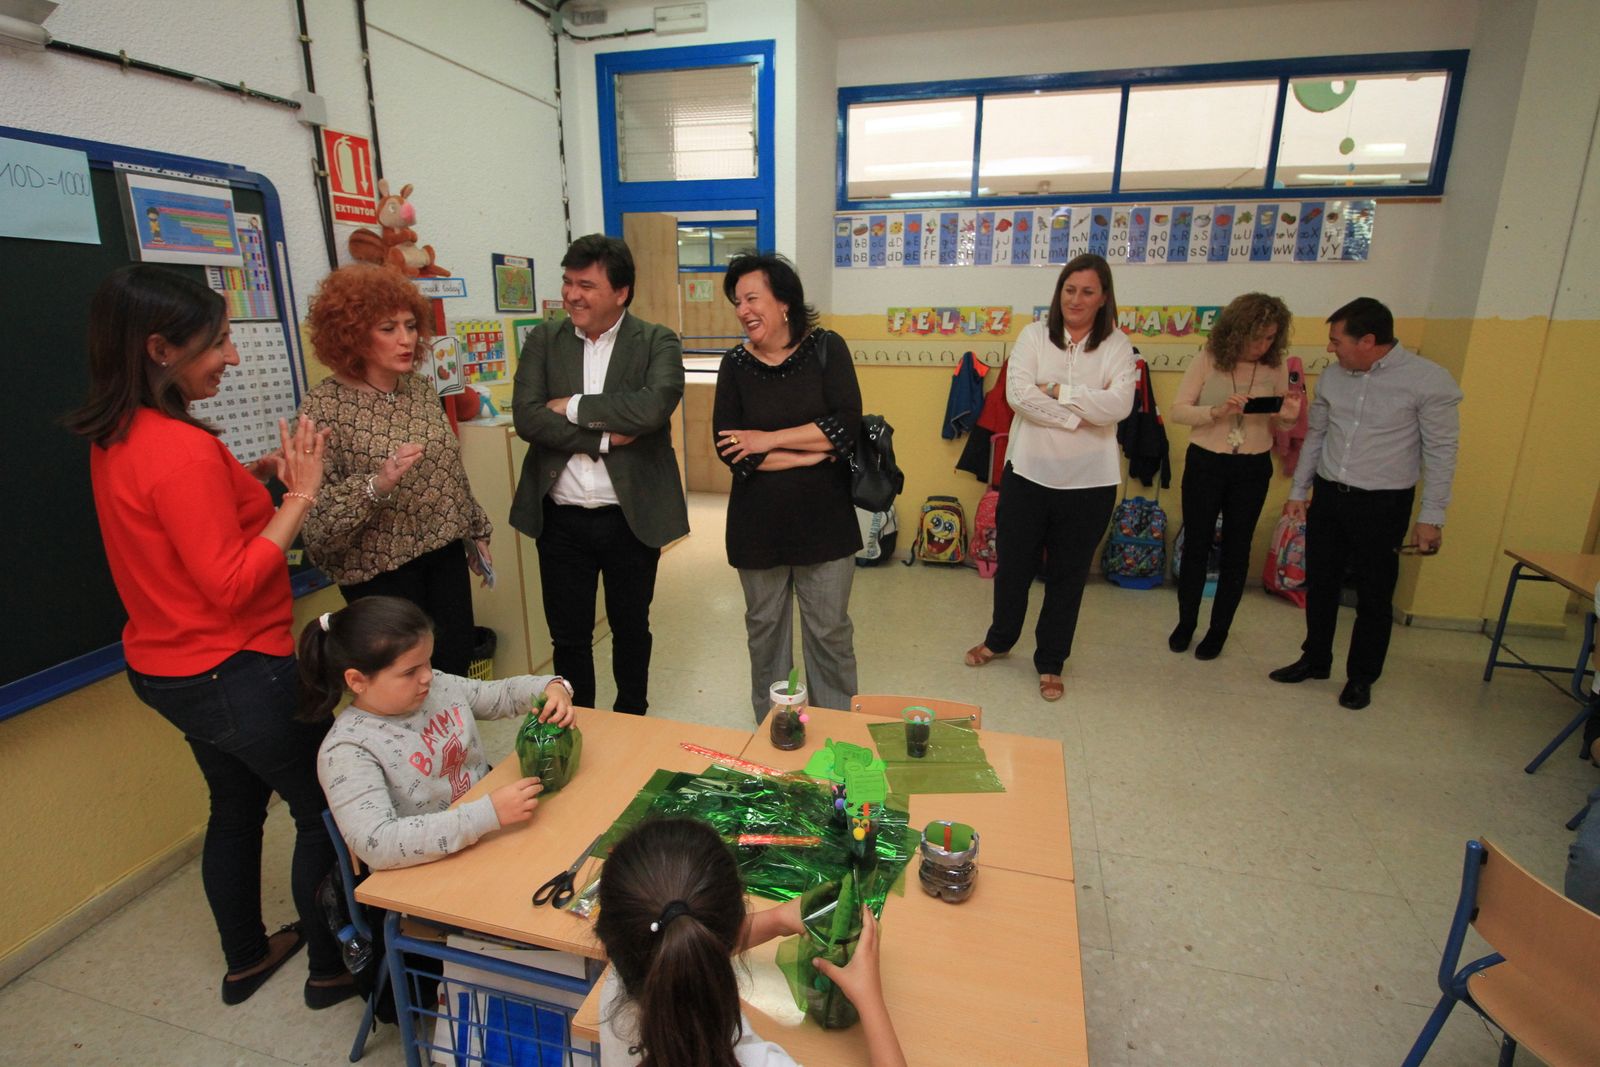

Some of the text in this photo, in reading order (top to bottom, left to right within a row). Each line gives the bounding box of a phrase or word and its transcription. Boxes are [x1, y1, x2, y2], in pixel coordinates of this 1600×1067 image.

[336, 204, 376, 216] EXTINTOR
[894, 310, 1006, 331] FELIZ
[409, 706, 464, 777] BAMM!
